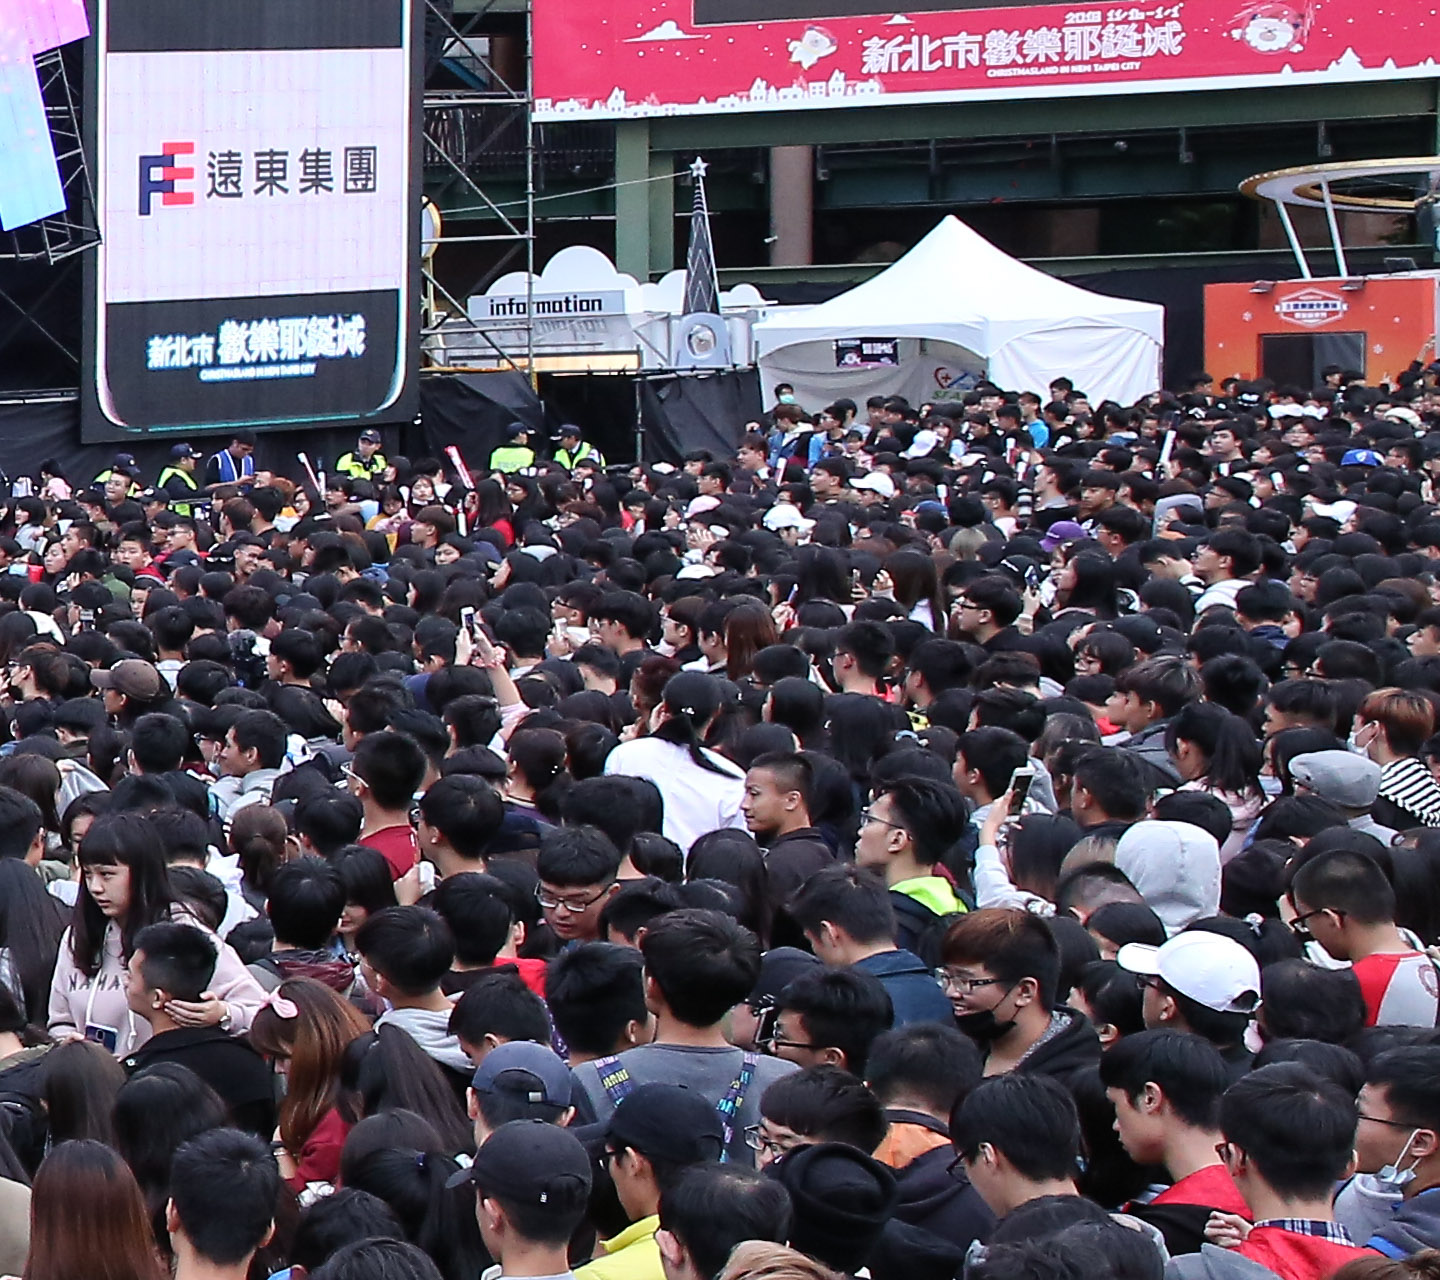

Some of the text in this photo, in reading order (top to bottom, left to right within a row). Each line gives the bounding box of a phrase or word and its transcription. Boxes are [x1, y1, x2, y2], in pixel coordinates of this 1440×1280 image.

[206, 146, 378, 199] 遠東集團
[146, 334, 216, 370] 新北市
